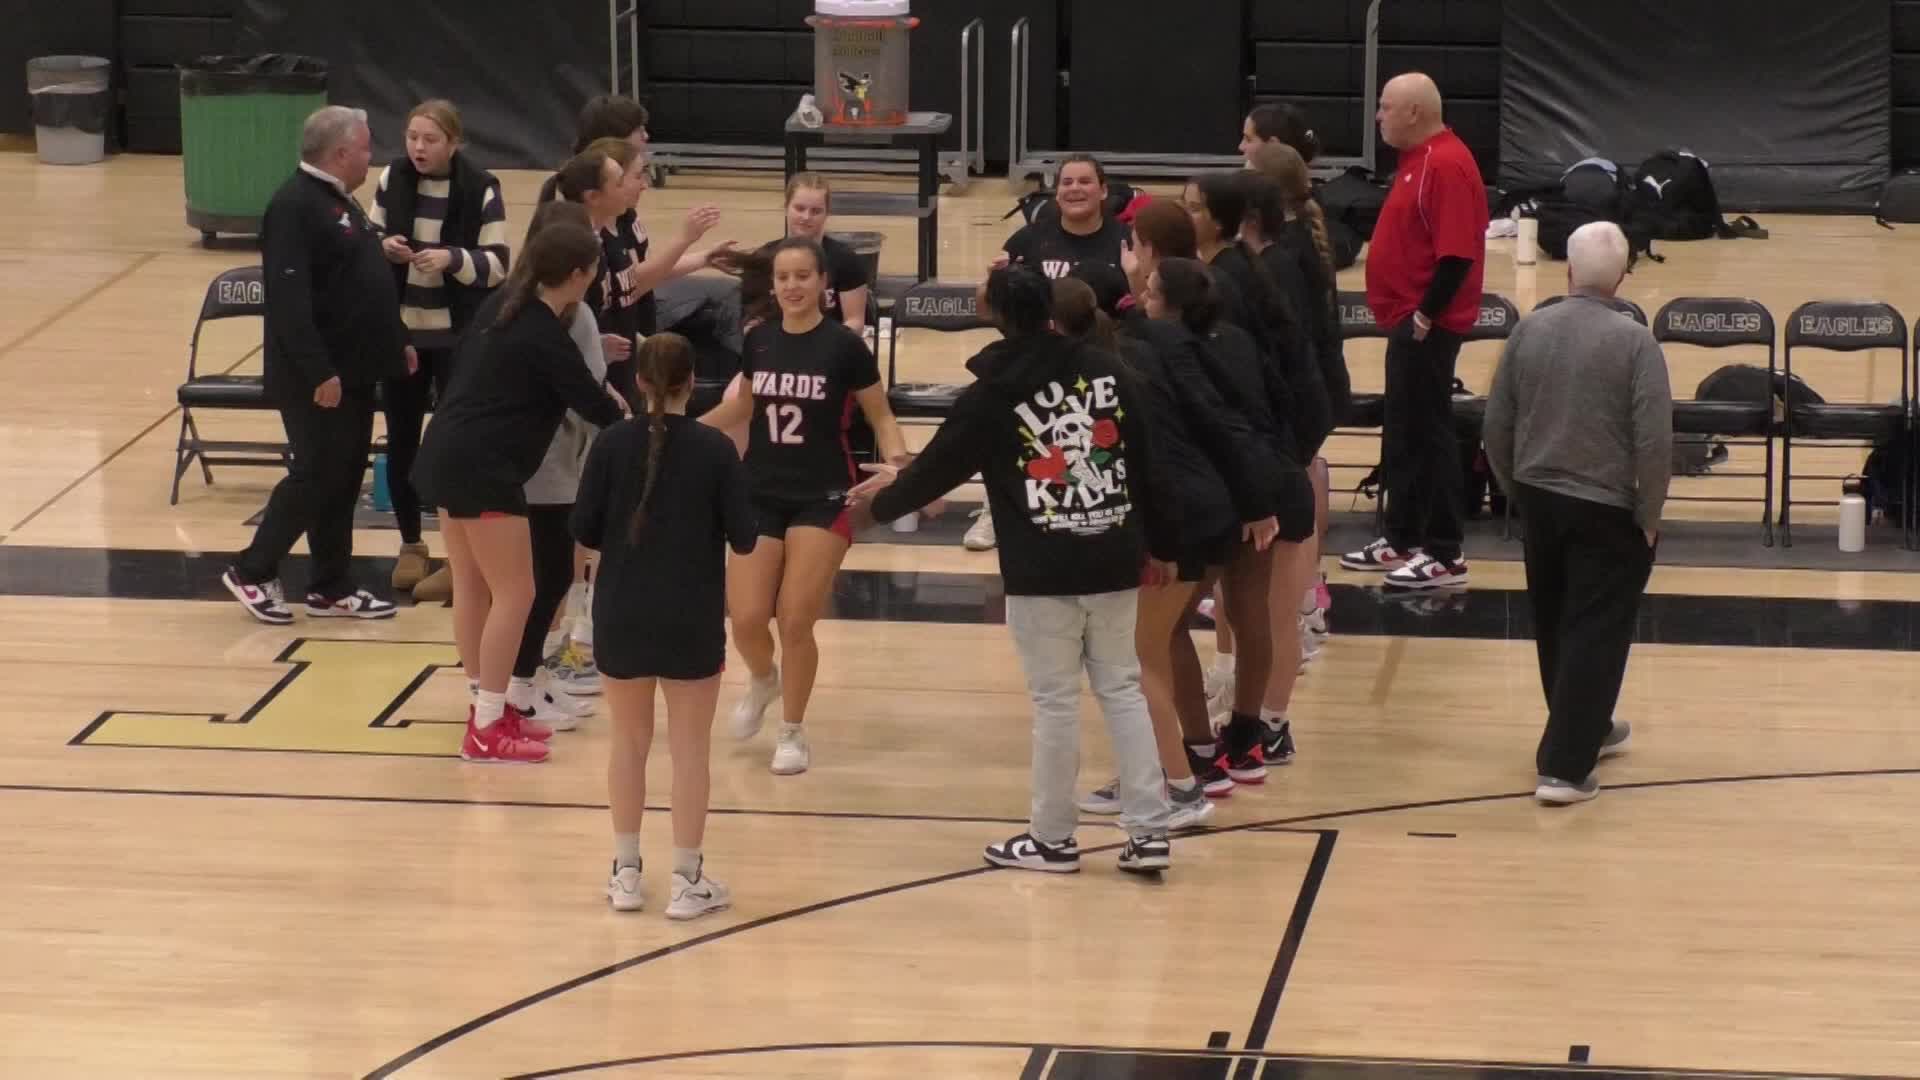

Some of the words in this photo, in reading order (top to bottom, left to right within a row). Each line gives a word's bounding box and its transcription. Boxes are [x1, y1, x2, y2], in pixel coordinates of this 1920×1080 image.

[219, 281, 264, 304] EAG
[905, 297, 977, 316] EAGLE
[1668, 311, 1761, 332] EAGLES
[1800, 315, 1894, 336] EAGLES
[752, 371, 827, 400] WARDE
[1014, 375, 1119, 436] LOVE
[766, 403, 804, 444] 12
[1025, 457, 1127, 509] KILLS
